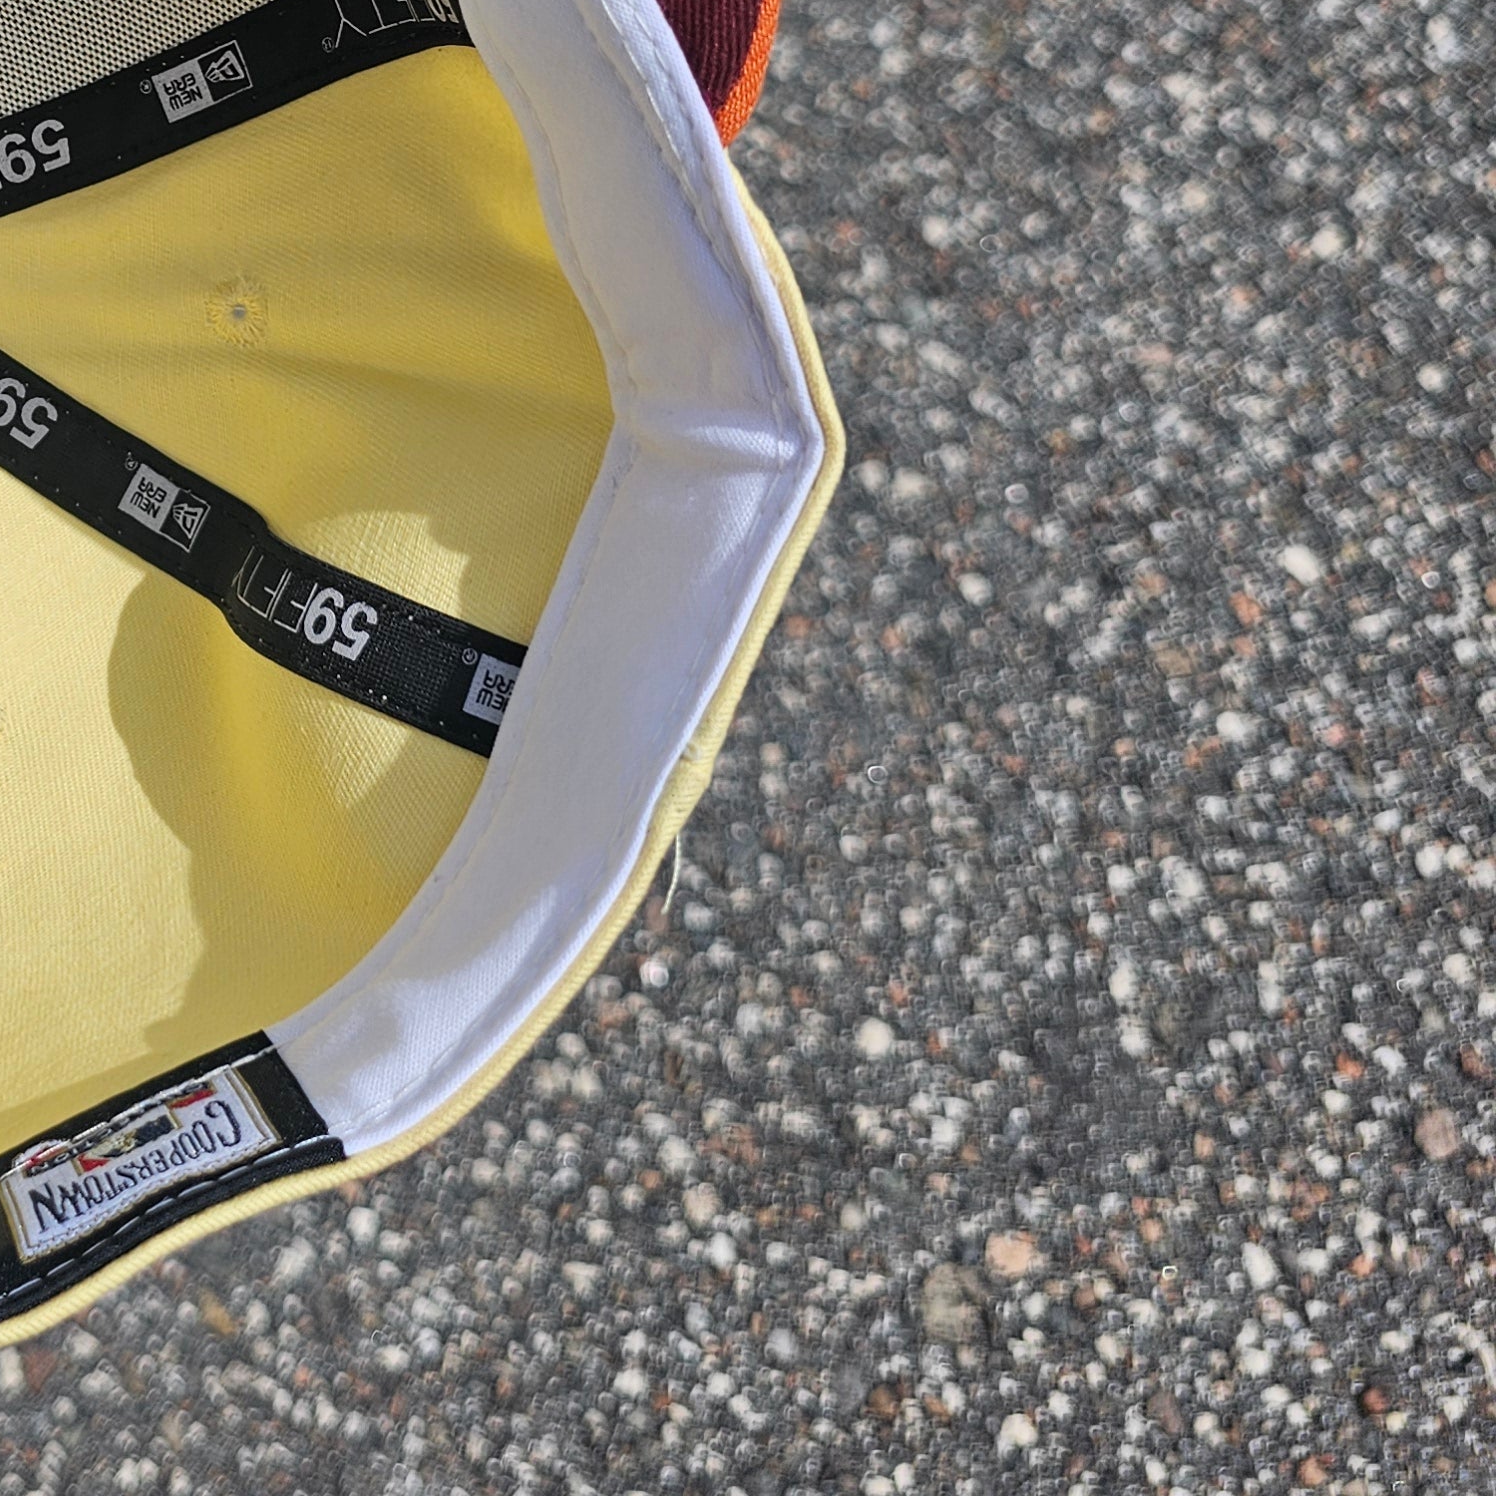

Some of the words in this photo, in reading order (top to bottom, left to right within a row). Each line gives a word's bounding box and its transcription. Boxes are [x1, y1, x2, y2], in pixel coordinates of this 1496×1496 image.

[162, 71, 197, 97] ERA
[168, 86, 203, 112] NEW
[137, 476, 168, 504] ERA
[129, 490, 162, 519] NEW
[27, 1099, 242, 1234] COOPERSTOWN
